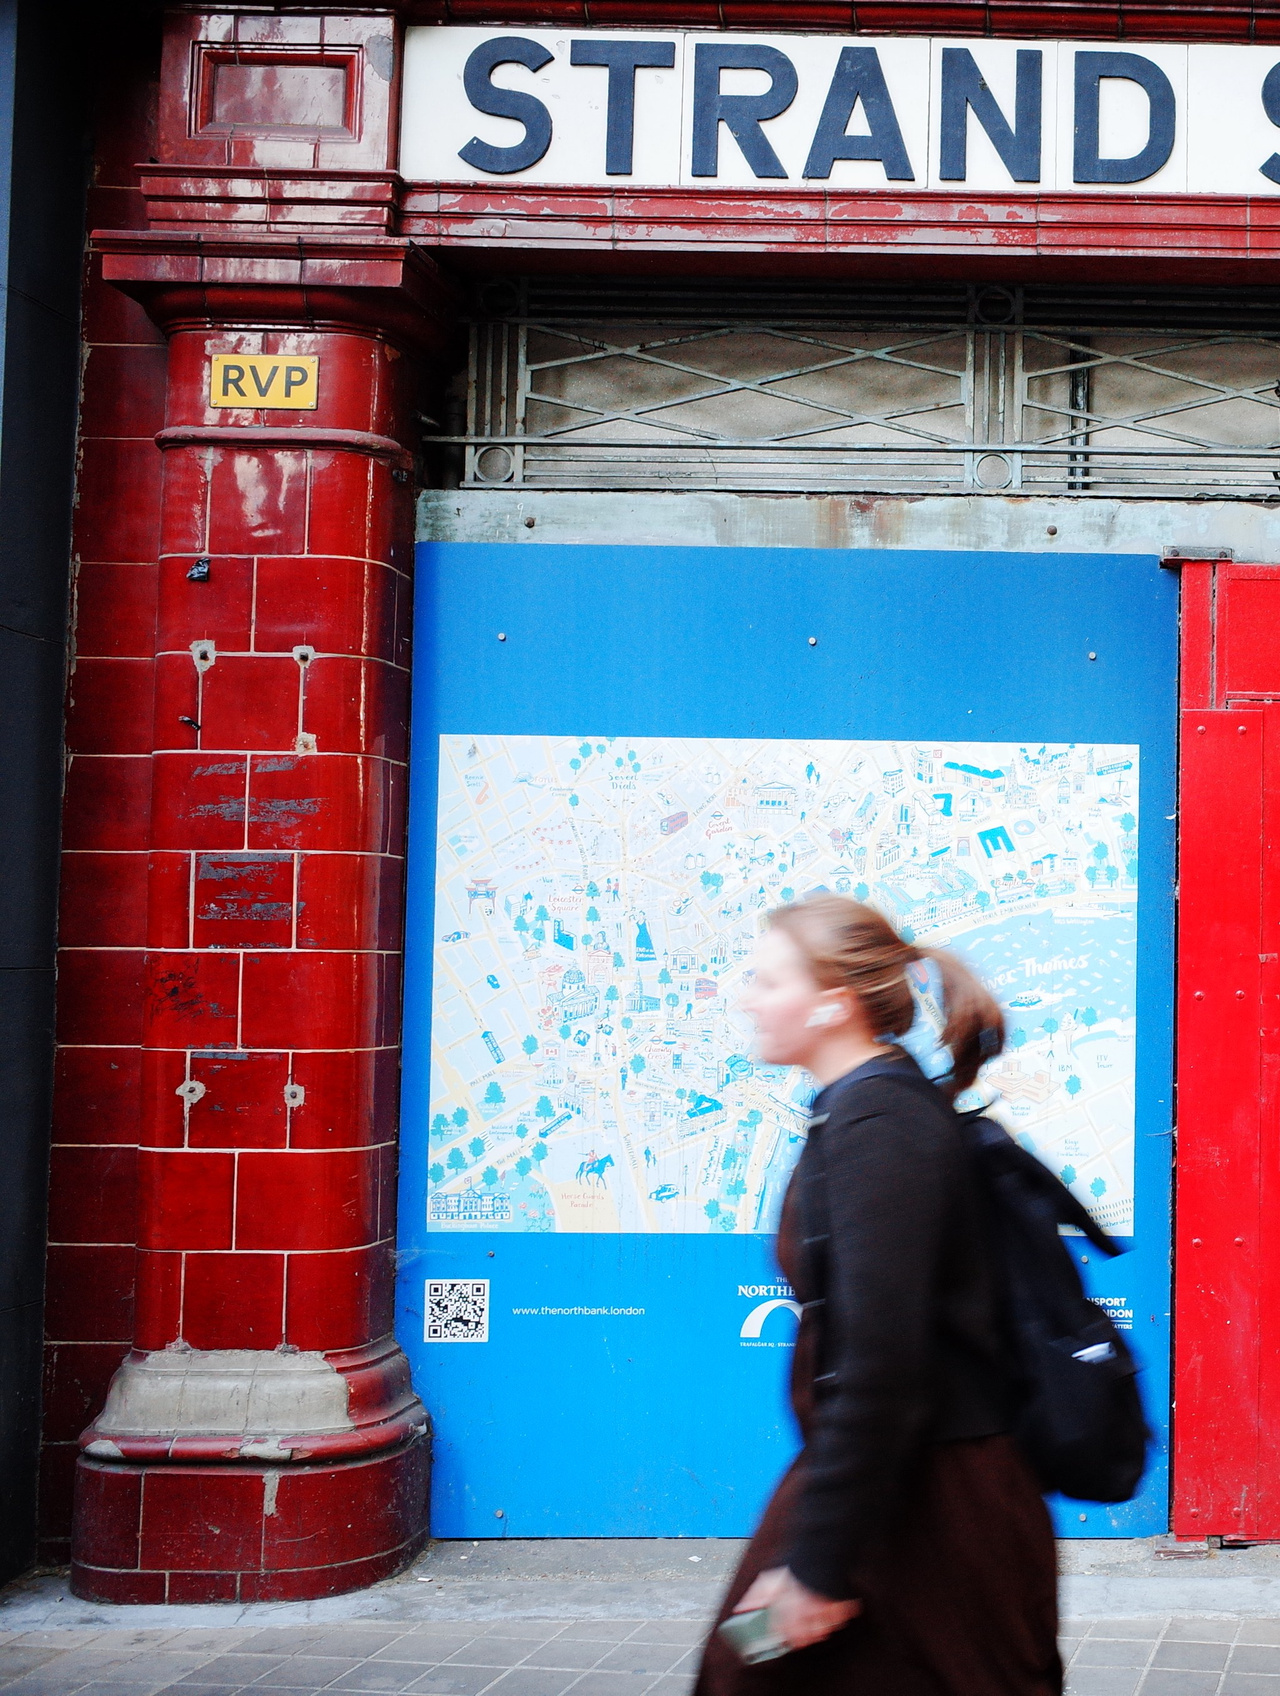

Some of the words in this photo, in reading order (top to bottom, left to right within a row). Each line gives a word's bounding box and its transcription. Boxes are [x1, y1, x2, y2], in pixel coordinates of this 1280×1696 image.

[458, 37, 1175, 185] STRAND
[222, 364, 309, 398] RVP
[608, 772, 638, 781] Seven
[612, 781, 637, 790] Dials
[705, 825, 733, 840] Garden
[552, 903, 579, 914] Square
[1018, 953, 1093, 977] Thames
[737, 1285, 796, 1298] NORTHB
[1086, 1297, 1127, 1306] NSPORT
[512, 1306, 646, 1316] www.thenorthbank.london
[1102, 1309, 1134, 1319] NDON
